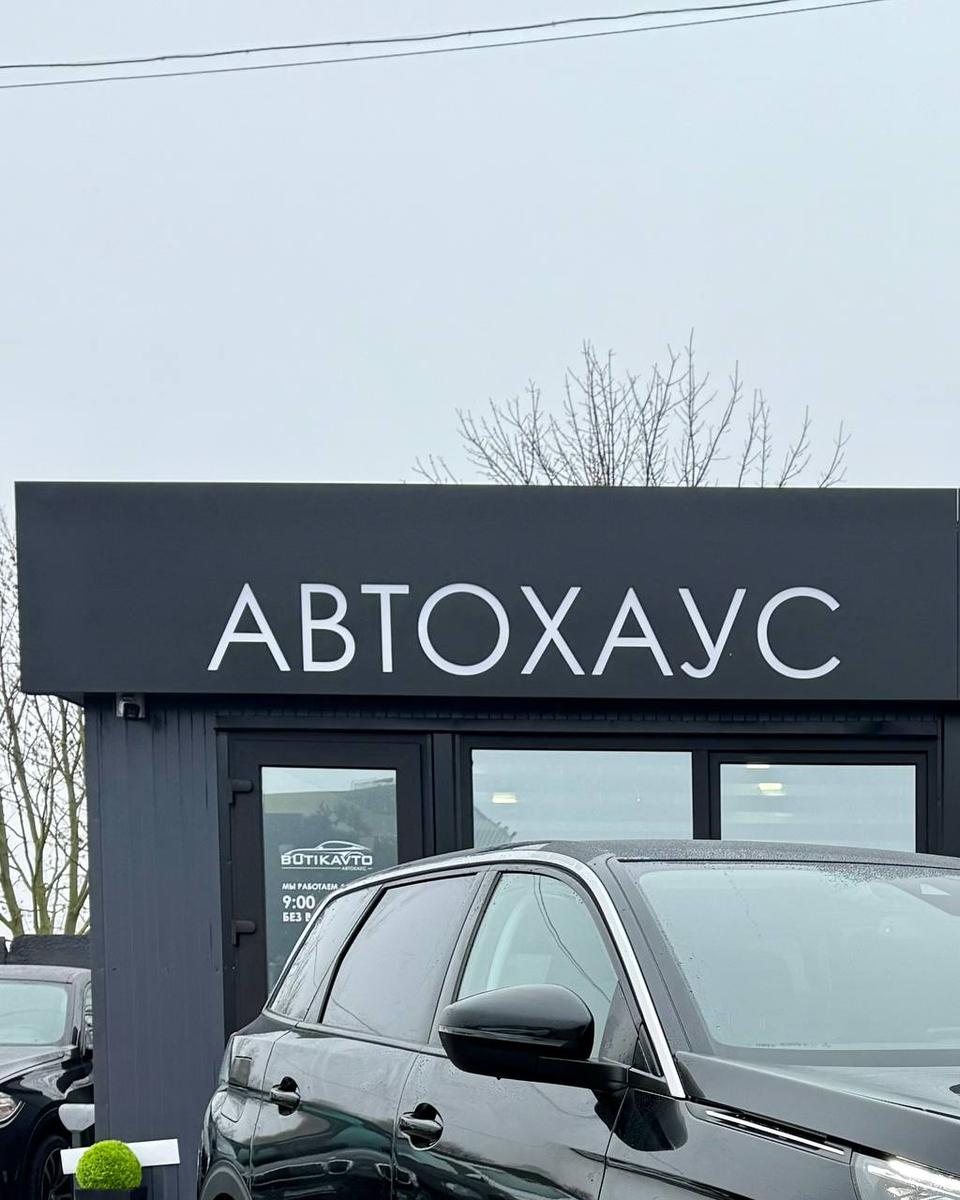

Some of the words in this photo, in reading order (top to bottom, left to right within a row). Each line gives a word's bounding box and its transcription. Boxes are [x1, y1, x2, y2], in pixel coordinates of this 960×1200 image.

[207, 582, 842, 680] АВТОХАУС
[281, 854, 373, 866] BUTIKAVTO
[282, 883, 296, 891] МЫ
[297, 883, 338, 891] РАБОТАЕМ
[282, 895, 316, 909] 9:00
[282, 912, 302, 922] БЕЗ
